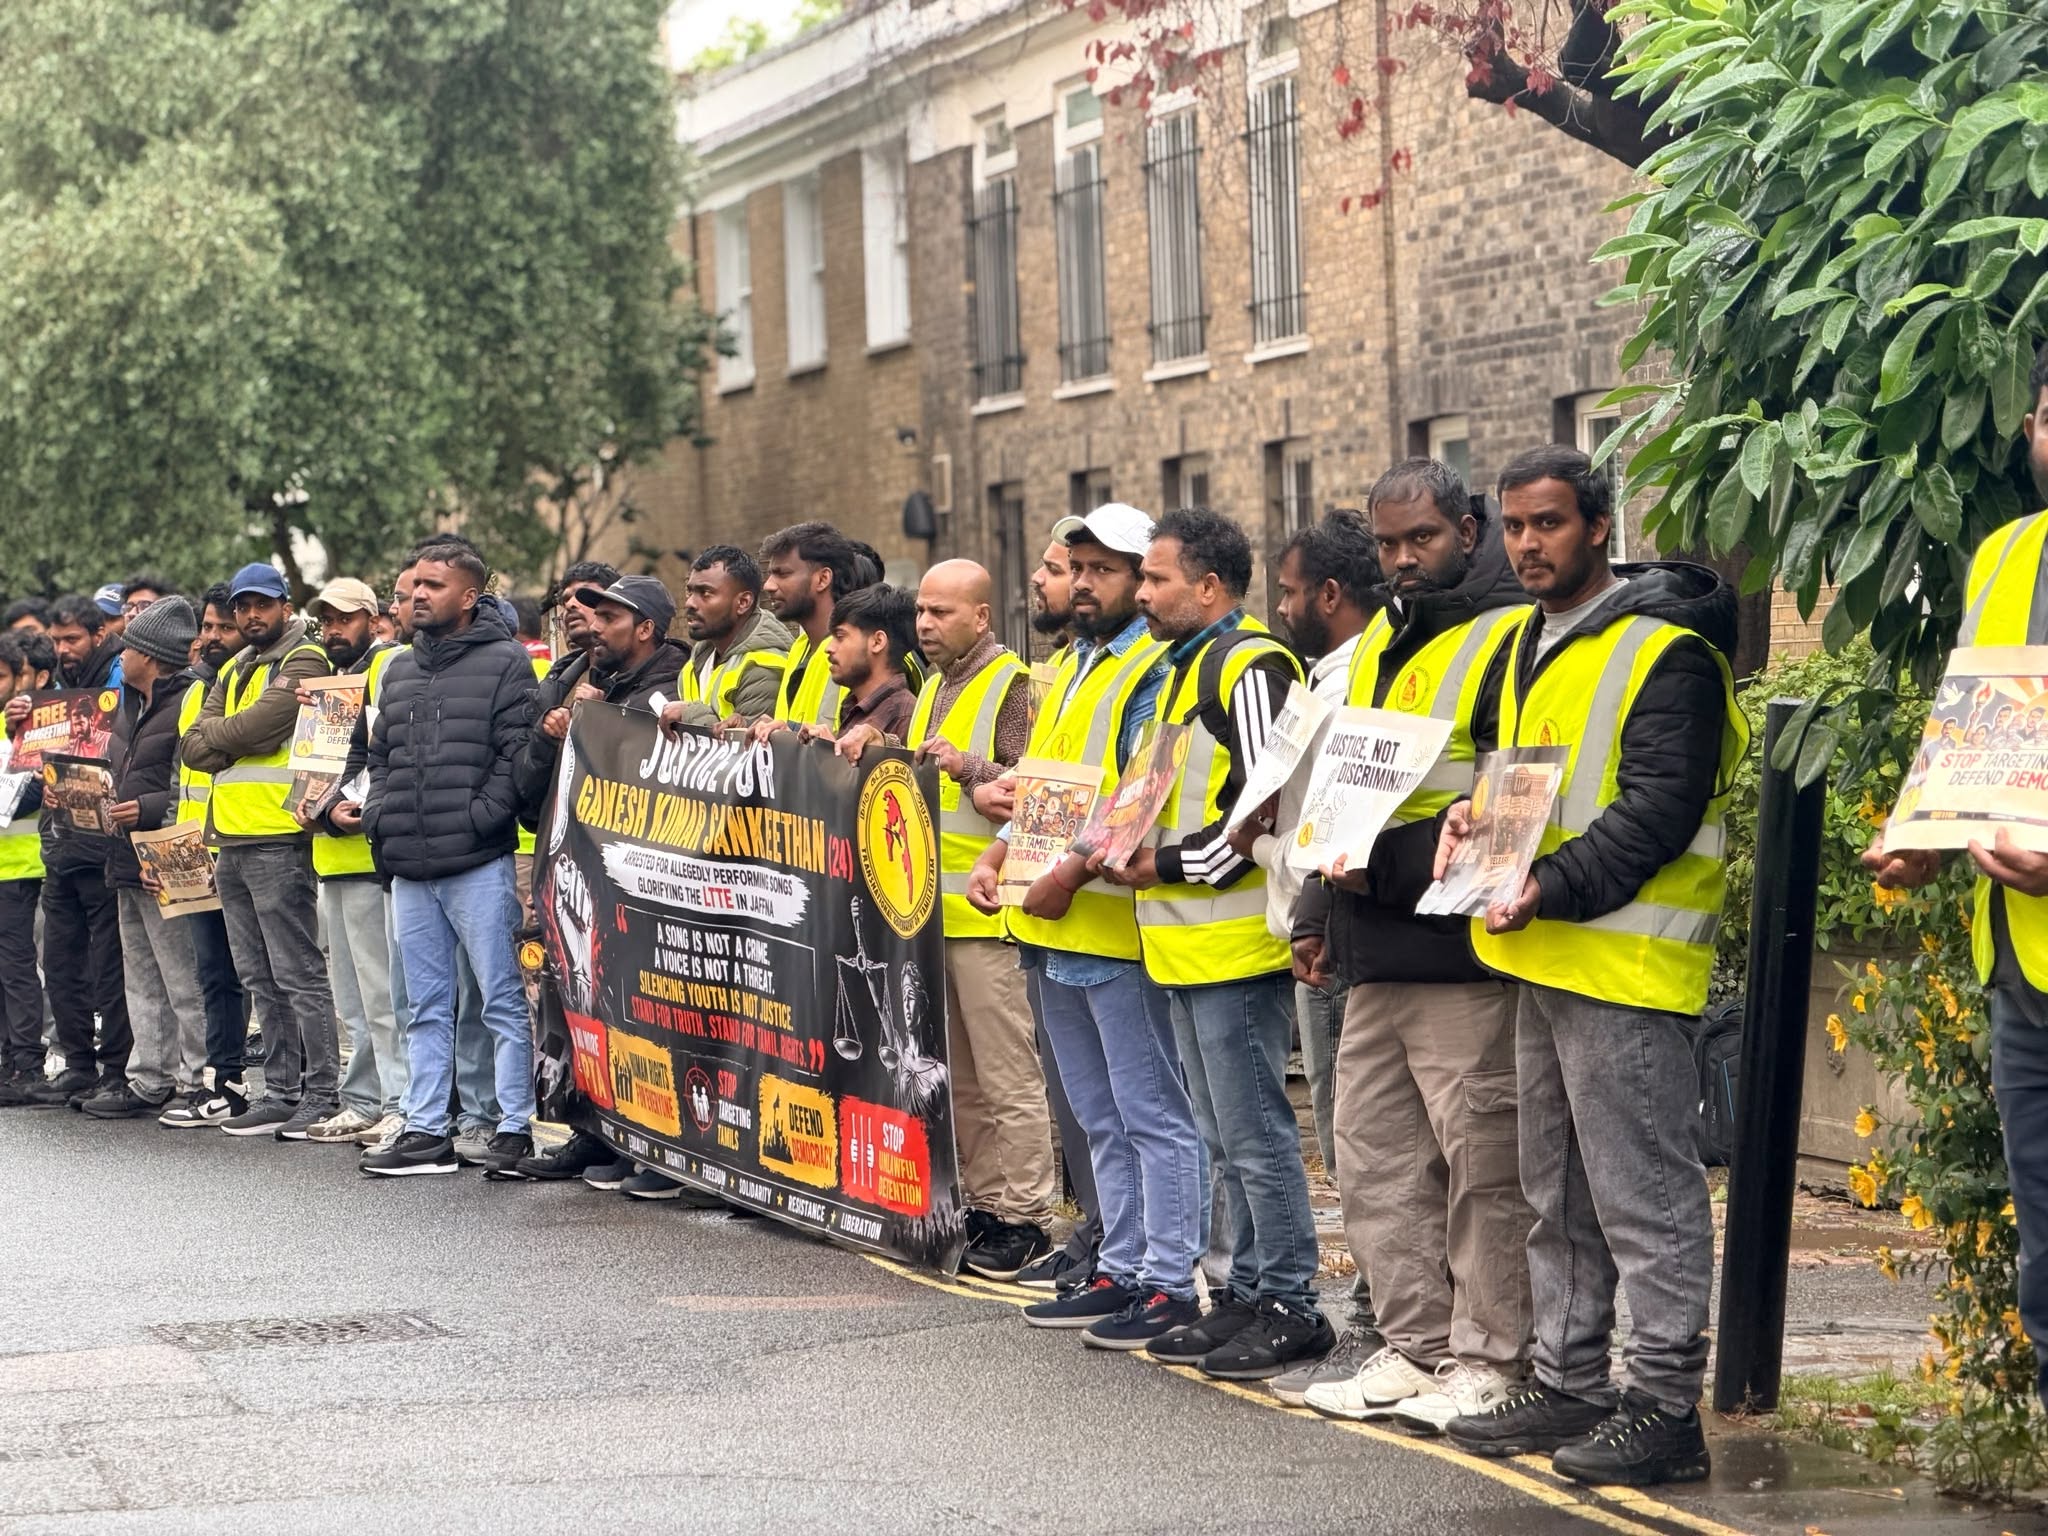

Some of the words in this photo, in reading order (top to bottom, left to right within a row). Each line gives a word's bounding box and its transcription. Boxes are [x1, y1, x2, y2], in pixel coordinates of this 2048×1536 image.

[33, 701, 68, 730] FREE
[319, 726, 341, 737] STOP
[640, 725, 740, 793] JUSTICE
[1326, 733, 1368, 763] JUSTICE,
[1371, 738, 1401, 765] NOT
[1941, 753, 1982, 769] STOP
[1948, 770, 2004, 786] DEFEND
[576, 774, 650, 840] GANESH
[647, 792, 707, 851] KUMAR
[702, 802, 826, 875] SANKEETHAN
[828, 834, 854, 884] (24)
[622, 850, 655, 873] ARRESTED
[655, 856, 669, 875] FOR
[671, 858, 711, 883] ALLEGEDLY
[713, 867, 769, 890] PERFORMING
[769, 876, 793, 897] SONGS
[638, 877, 684, 901] GLORIFYING
[685, 886, 702, 906] THE
[703, 886, 734, 910] LTTE
[736, 893, 748, 910] IN
[749, 895, 775, 919] JAFFNA
[657, 922, 664, 944] A
[665, 924, 689, 950] SONG
[692, 930, 703, 953] IS
[704, 931, 730, 956] NOT
[735, 936, 743, 960] A
[745, 937, 770, 966] CRIME.
[655, 947, 661, 969] A
[662, 949, 689, 976] VOICE
[691, 955, 702, 979] IS
[704, 957, 729, 982] NOT
[734, 961, 742, 985] A
[743, 963, 776, 995] THREAT.
[639, 969, 685, 1005] SILENCING
[687, 982, 729, 1012] YOUTH
[730, 989, 741, 1014] IS
[742, 991, 759, 1020] NOT
[759, 998, 794, 1032] JUSTICE.
[631, 995, 655, 1025] STAND
[655, 1002, 672, 1030] FOR
[672, 1007, 707, 1038] TRUTH.
[709, 1014, 741, 1044] STAND
[741, 1021, 755, 1049] FOR
[757, 1026, 779, 1058] TAMIL
[718, 1070, 737, 1099] STOP
[718, 1100, 752, 1131] TARGETING
[789, 1102, 824, 1139] DEFEND
[717, 1124, 739, 1152] TAMILS
[882, 1122, 905, 1153] STOP
[792, 1137, 834, 1171] DEMOCRACY
[878, 1151, 920, 1182] UNLAWFUL
[702, 1162, 726, 1186] FREEDOM
[738, 1177, 771, 1205] SOLIDARITY
[788, 1194, 826, 1223] RESISTANCE
[840, 1215, 882, 1241] LIBERATION
[878, 1176, 923, 1208] DETENTION
[1273, 1302, 1289, 1316] FILA
